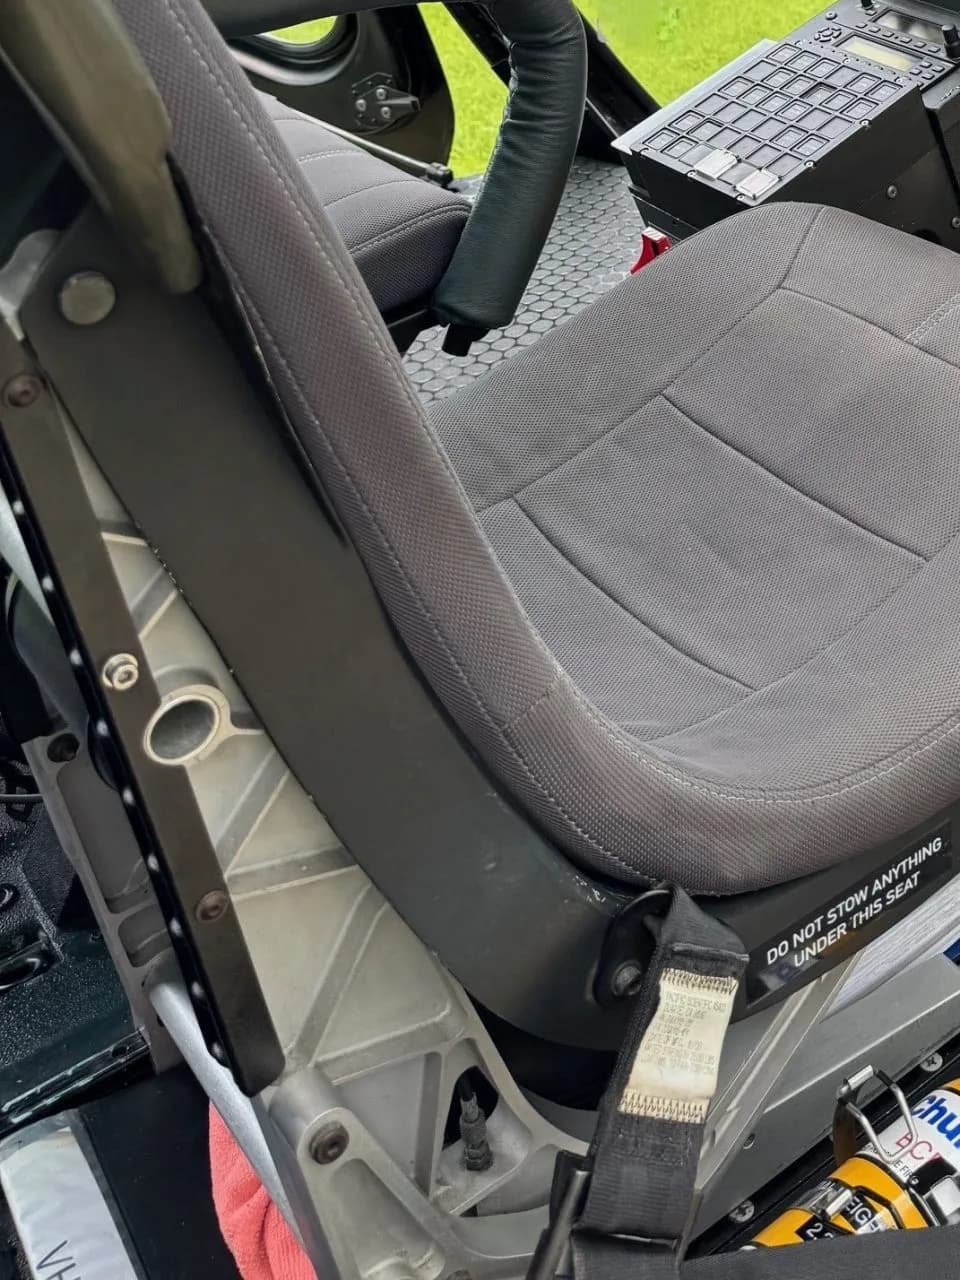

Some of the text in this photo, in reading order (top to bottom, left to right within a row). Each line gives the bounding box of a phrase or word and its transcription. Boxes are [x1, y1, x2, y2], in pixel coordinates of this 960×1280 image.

[767, 837, 942, 965] DO NOT STOW ANYTHING
[793, 871, 921, 969] UNDER THIS SEAT
